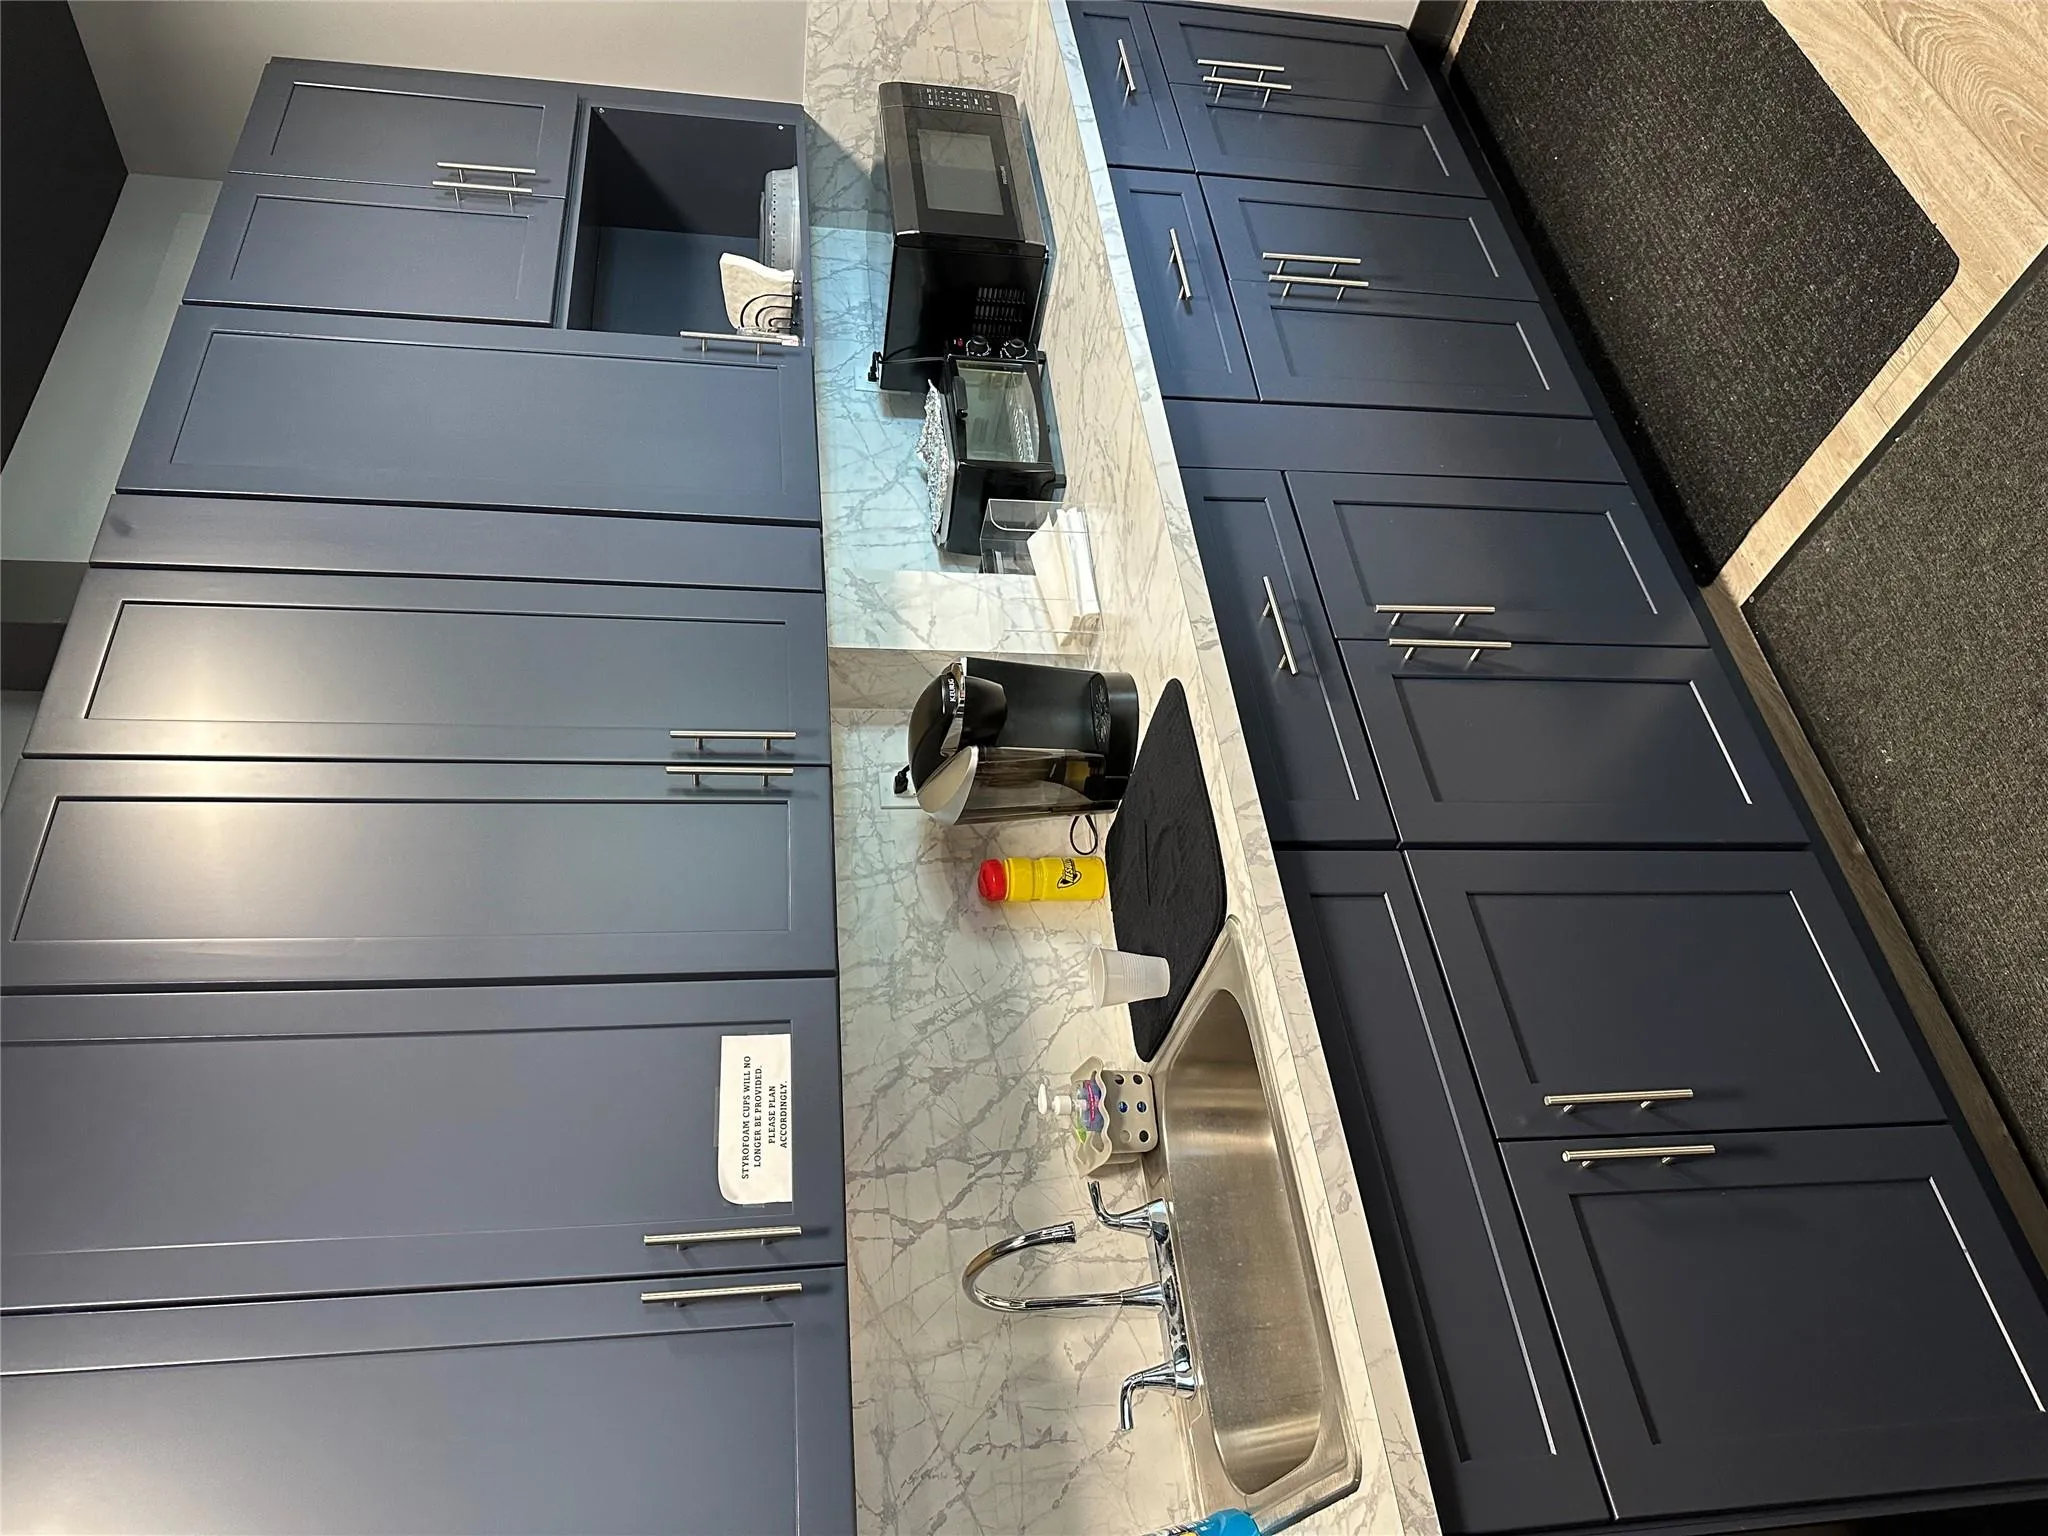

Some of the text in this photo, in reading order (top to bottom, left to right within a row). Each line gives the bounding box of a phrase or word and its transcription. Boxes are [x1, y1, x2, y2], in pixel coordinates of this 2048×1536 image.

[948, 679, 957, 702] KEURIG
[741, 1056, 751, 1179] STYROFOAM CUPS WILL NO
[755, 1115, 761, 1127] BE
[768, 1111, 776, 1144] PLEASE
[780, 1081, 788, 1148] ACCORDINGLY.
